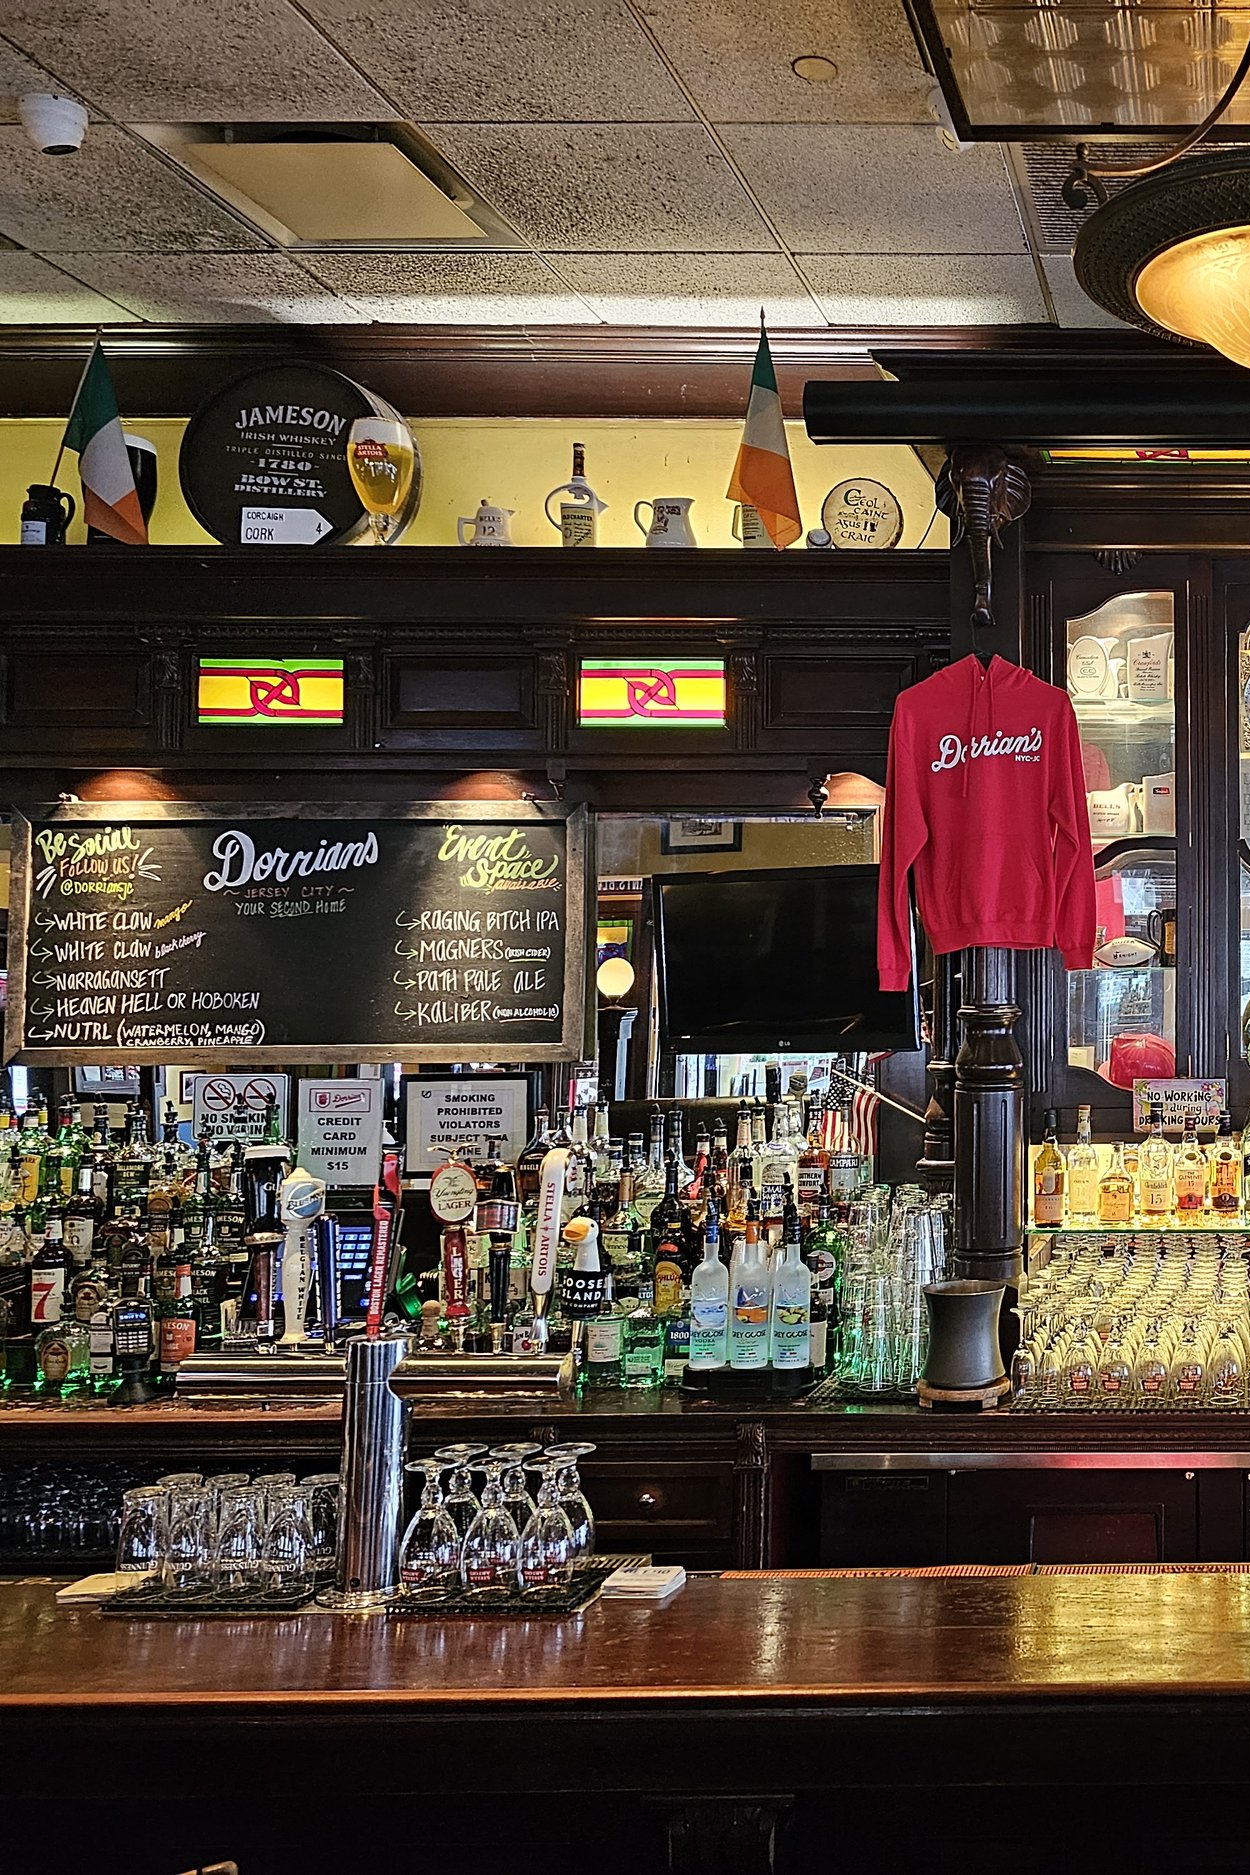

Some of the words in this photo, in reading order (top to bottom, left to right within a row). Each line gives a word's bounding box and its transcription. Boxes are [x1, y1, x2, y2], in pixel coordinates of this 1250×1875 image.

[235, 405, 347, 436] JAMESON
[241, 431, 275, 441] IRISH
[280, 434, 337, 446] WHISKEY
[226, 446, 259, 455] TRIPLE
[266, 449, 314, 458] DISTILLED
[241, 474, 291, 486] BOW
[294, 478, 323, 489] ST.
[234, 484, 328, 498] DISTILLERY
[246, 528, 274, 540] CORK
[316, 523, 322, 534] 4
[483, 526, 496, 536] 12
[1015, 754, 1040, 762] NYC-JC
[35, 829, 66, 863] Be
[69, 827, 140, 862] Social
[438, 825, 526, 861] Event
[203, 830, 378, 891] Dorrians
[466, 854, 559, 888] Space
[244, 887, 290, 898] JERSEY
[302, 886, 334, 897] CITY
[53, 912, 107, 932] WHITE
[113, 912, 153, 930] CLAW
[153, 899, 193, 929] mango
[235, 902, 265, 915] YOUR
[270, 901, 310, 917] SECOND
[316, 899, 346, 913] HOME
[421, 910, 481, 931] RAGING
[487, 909, 530, 931] BITCH
[537, 911, 559, 931] IPA
[55, 940, 105, 962] WHITE
[113, 939, 152, 959] CLAW
[420, 938, 504, 962] MAGNERS
[56, 967, 171, 991] NARRAGANSETT
[417, 969, 457, 991] PATH
[464, 969, 502, 991] PALE
[514, 969, 546, 993] ALE
[57, 995, 117, 1017] HEAVEN
[121, 993, 163, 1015] HELL
[167, 993, 187, 1008] OR
[191, 992, 260, 1010] HOBOKEN
[418, 1000, 491, 1026] KALIBER
[53, 1022, 112, 1041] NUTRL
[445, 1094, 495, 1103] SMOKING
[1147, 1091, 1161, 1101] NO
[1164, 1090, 1212, 1102] WORKING
[437, 1107, 503, 1116] PROHIBITED
[1170, 1103, 1202, 1116] during
[201, 1114, 217, 1124] NO
[317, 1117, 362, 1126] CREDIT
[439, 1120, 501, 1130] VIOLATORS
[323, 1132, 356, 1141] CARD
[430, 1133, 480, 1143] SUBJECT
[311, 1147, 367, 1156] MINIMUM
[327, 1161, 349, 1171] $15
[830, 1158, 858, 1168] CAMPARI
[439, 1201, 471, 1211] LAGER
[544, 1182, 555, 1223] STELLA
[1150, 1194, 1162, 1204] 15
[538, 1235, 551, 1277] ARTOIS
[373, 1266, 383, 1288] LAGER
[32, 1282, 56, 1320] 7
[670, 1331, 689, 1339] 1800
